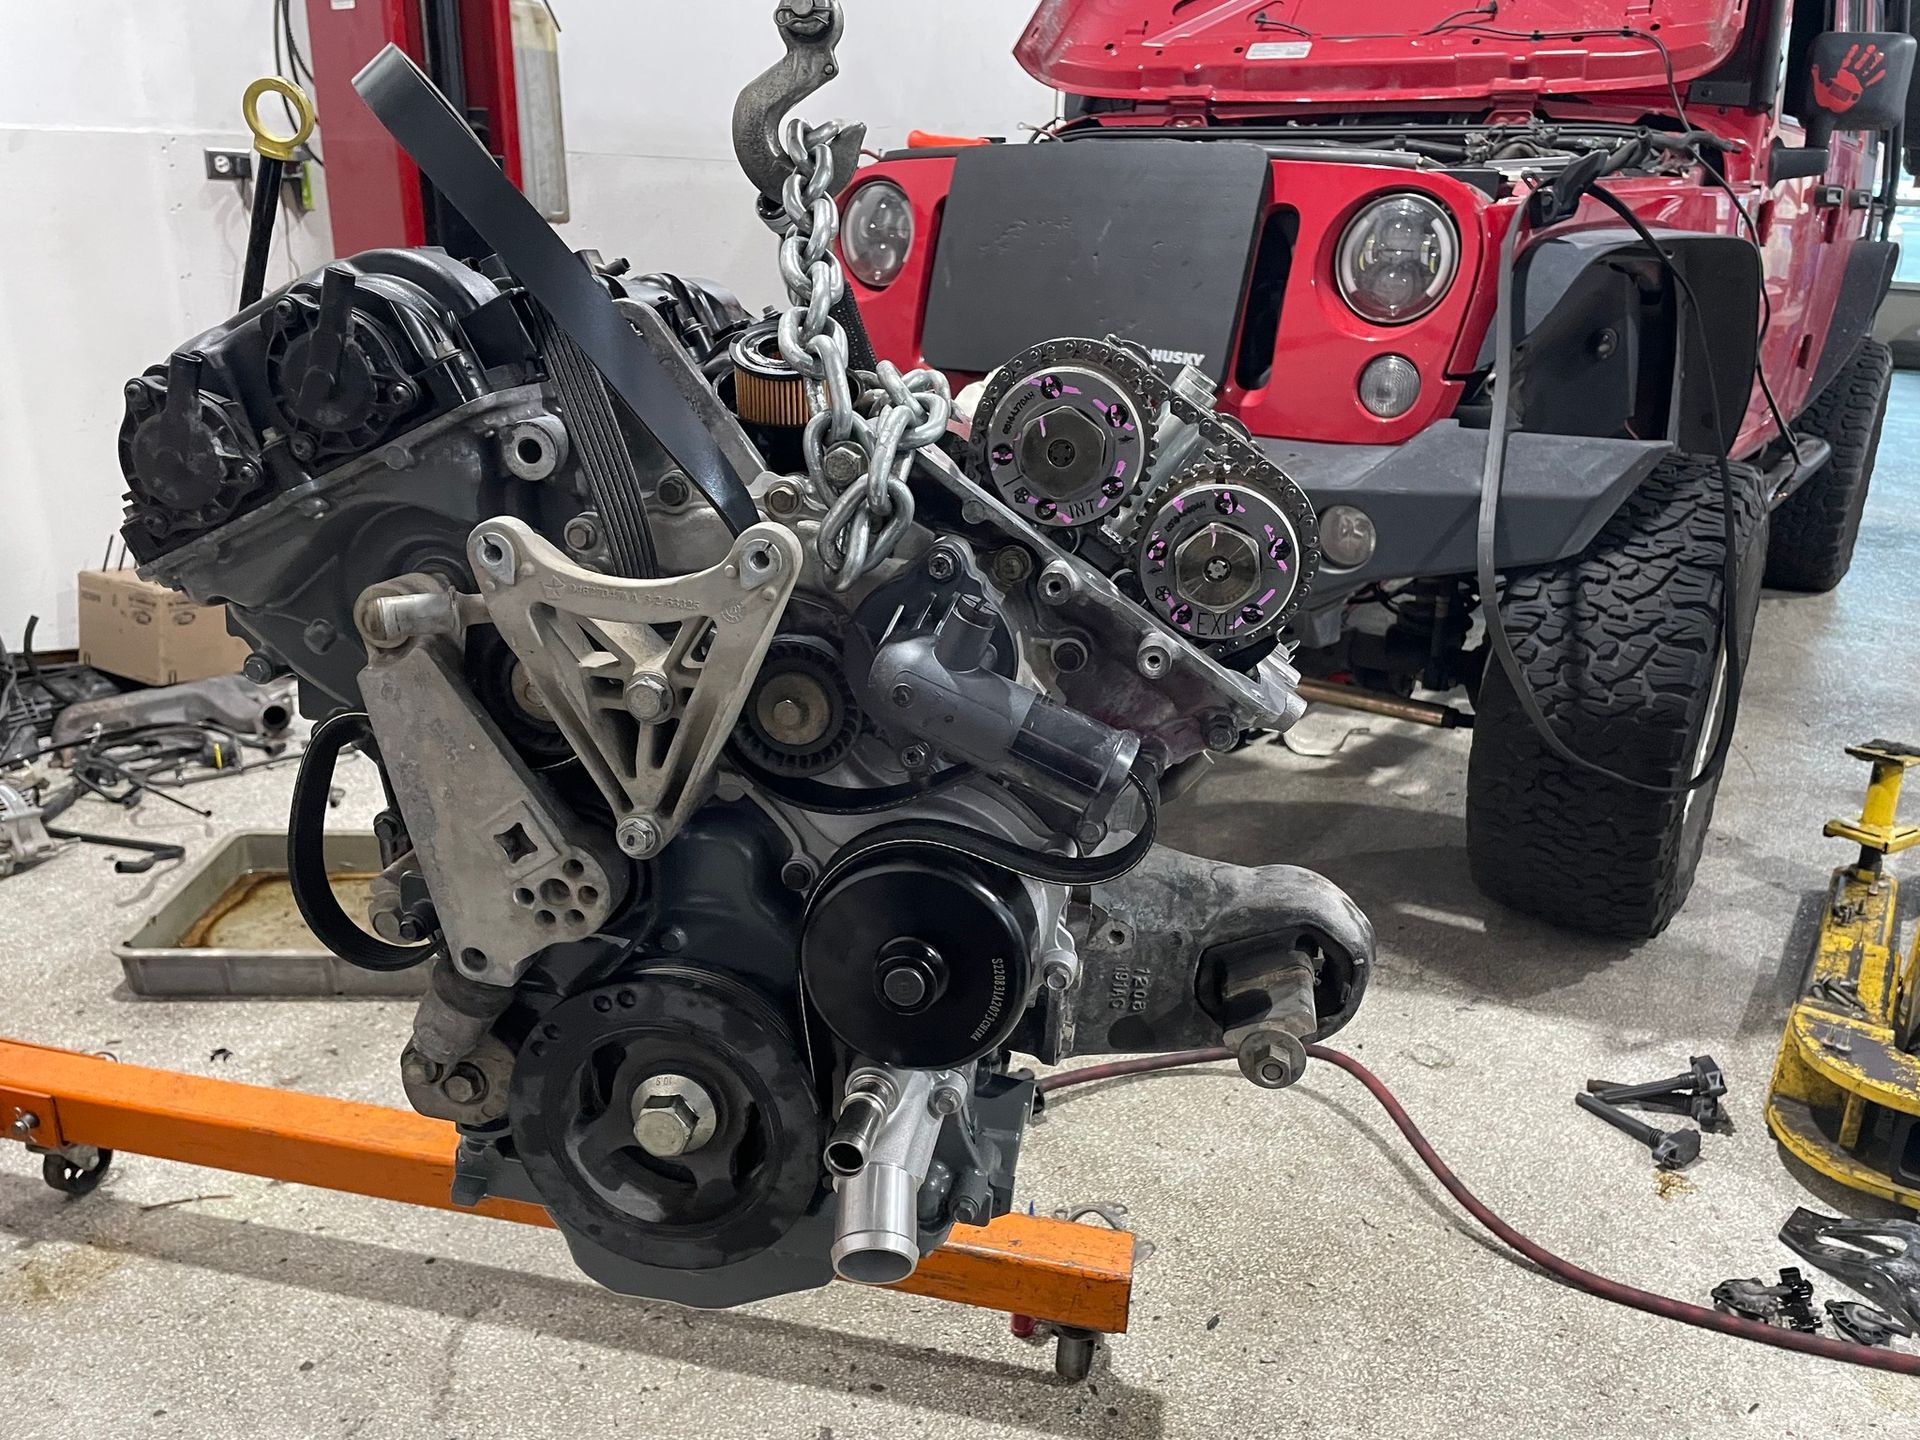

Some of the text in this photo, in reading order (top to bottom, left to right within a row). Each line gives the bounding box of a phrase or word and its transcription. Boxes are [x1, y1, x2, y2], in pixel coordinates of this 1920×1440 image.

[1151, 348, 1206, 367] HUSKY
[1068, 498, 1094, 519] INT
[1196, 612, 1237, 636] EXH
